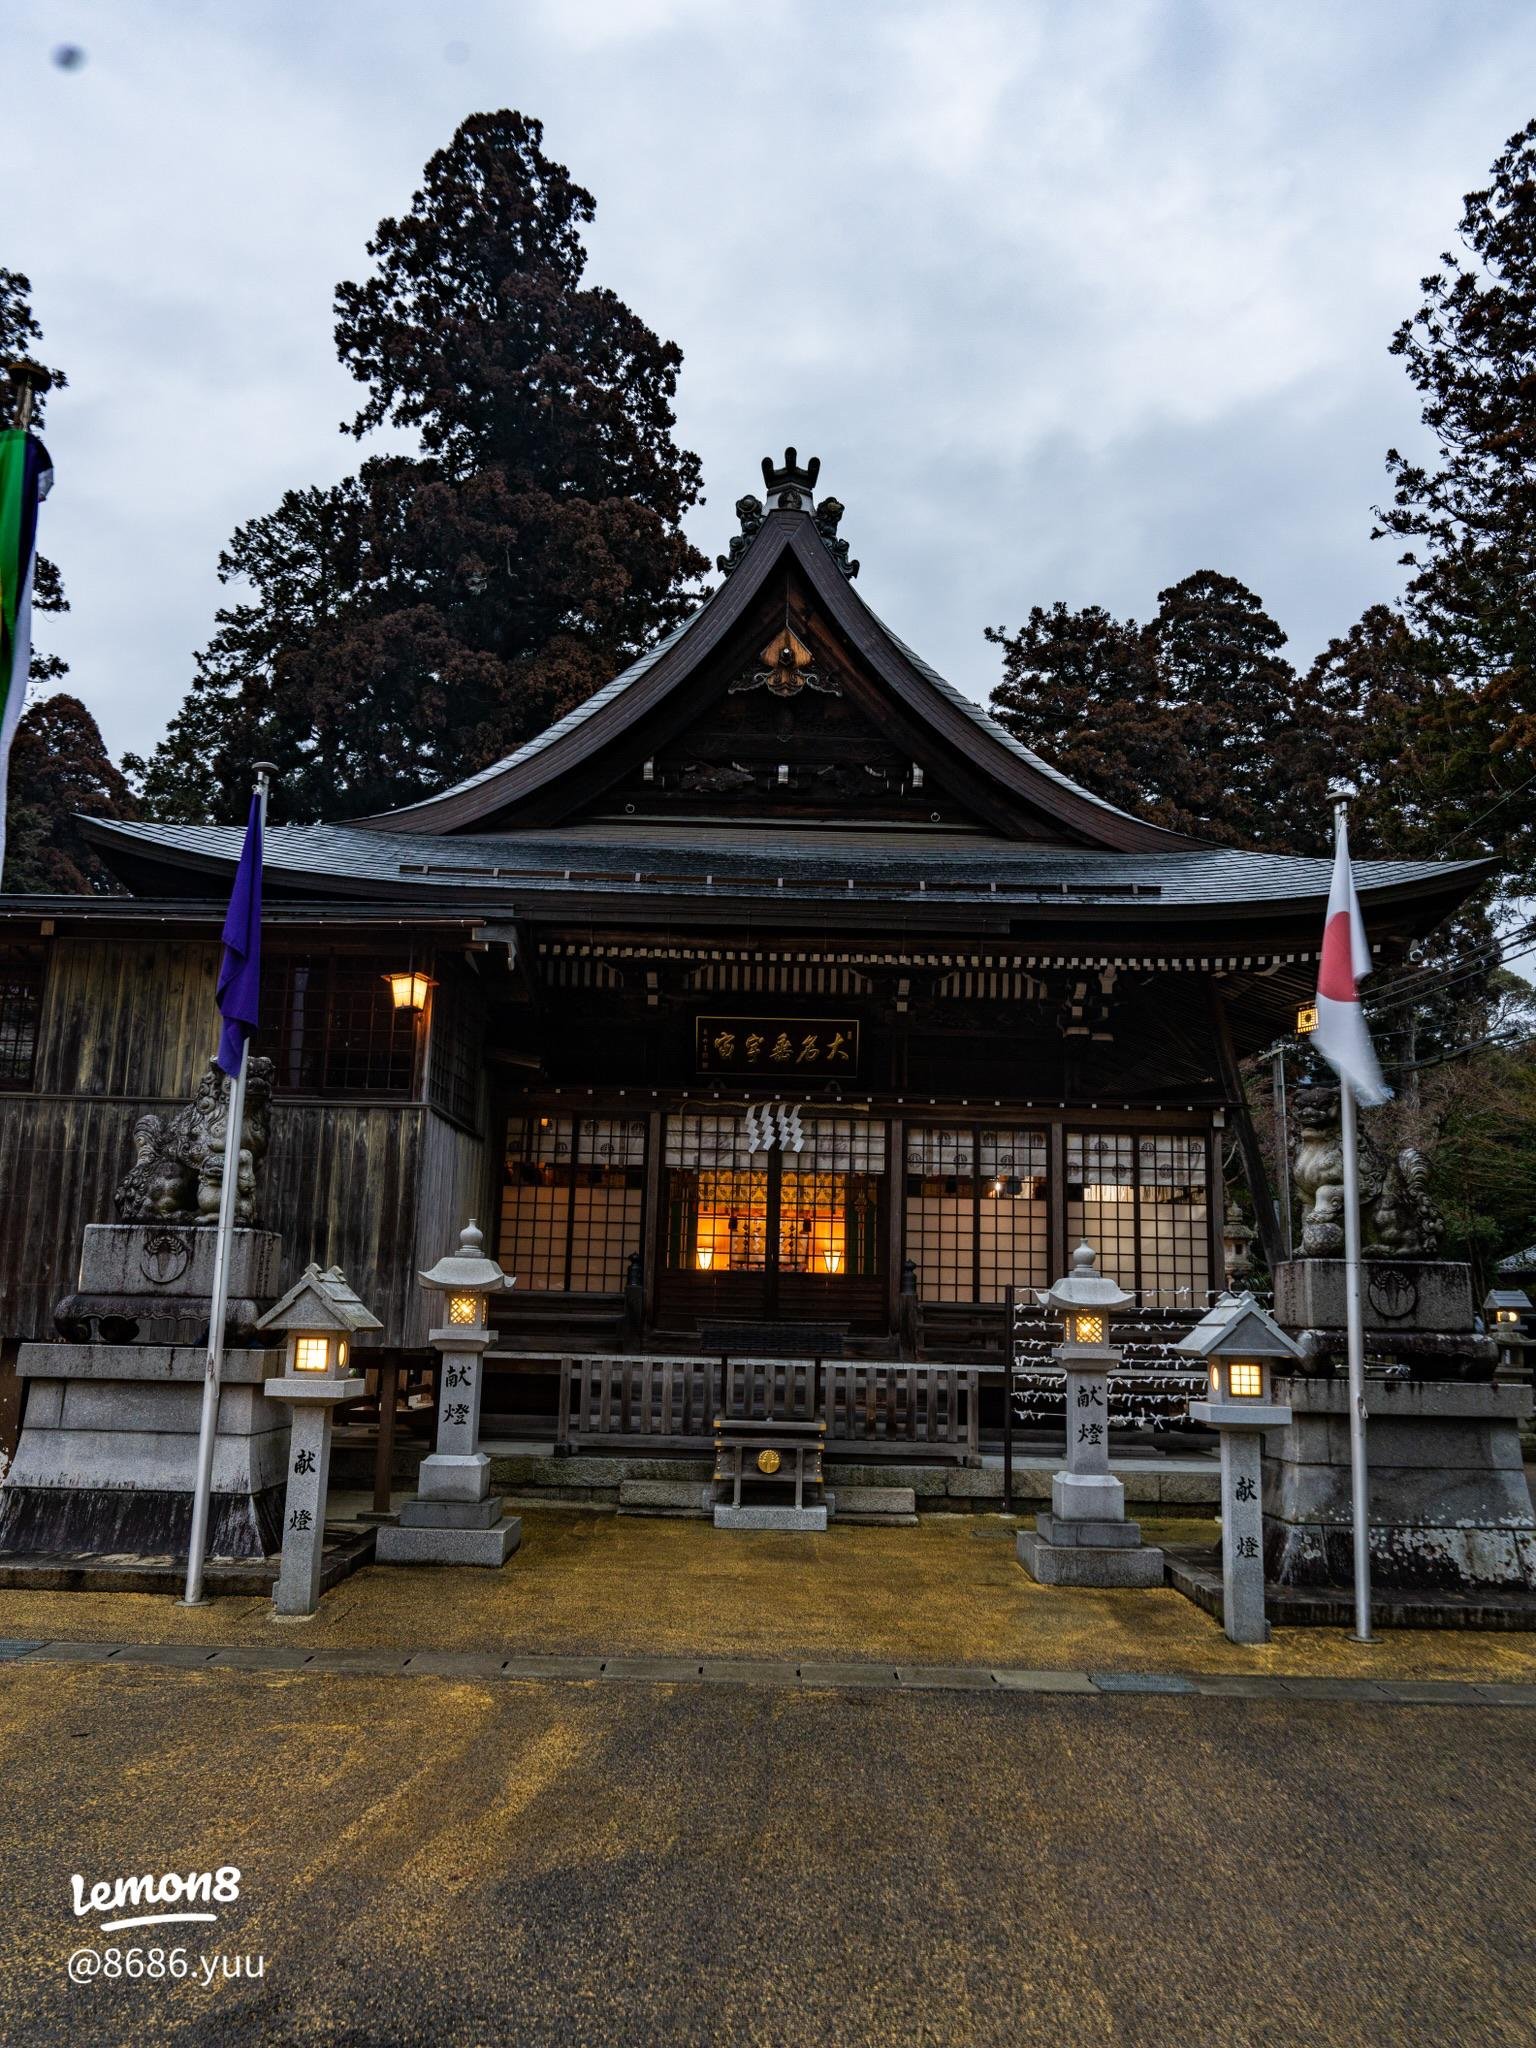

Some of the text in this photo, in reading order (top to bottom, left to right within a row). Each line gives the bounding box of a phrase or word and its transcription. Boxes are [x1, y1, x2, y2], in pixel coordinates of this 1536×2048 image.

[442, 1365, 472, 1426] 献燈
[1077, 1385, 1104, 1445] 献燈
[288, 1449, 316, 1531] 献燈
[1235, 1476, 1260, 1559] 献燈
